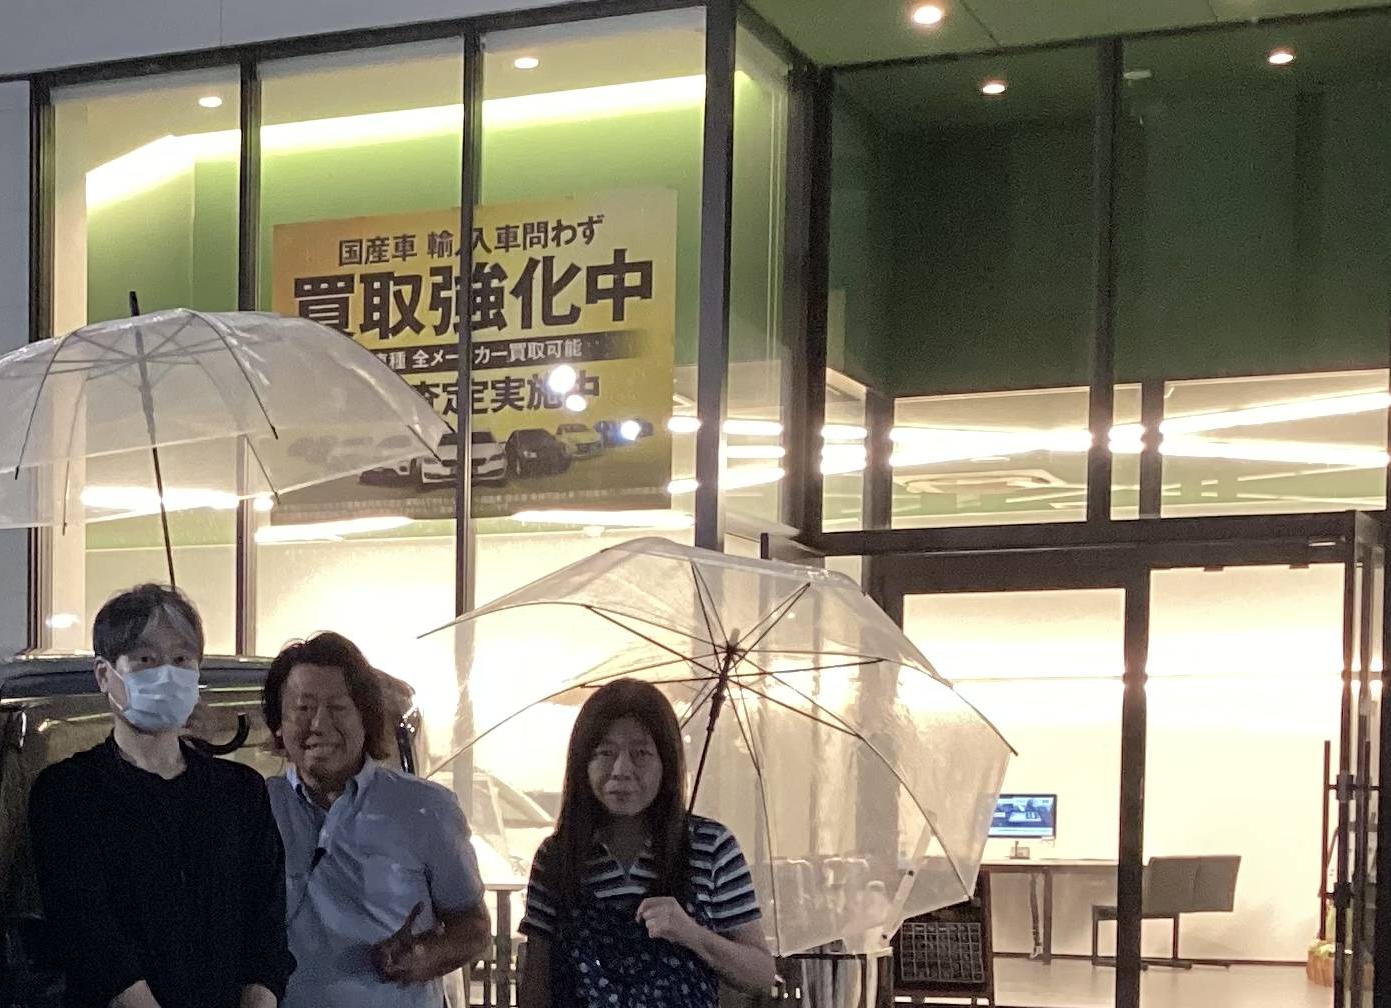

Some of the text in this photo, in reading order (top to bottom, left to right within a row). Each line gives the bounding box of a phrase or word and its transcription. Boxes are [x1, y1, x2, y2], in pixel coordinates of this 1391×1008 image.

[338, 234, 417, 267] 国産車
[293, 248, 653, 340] 買取強化中
